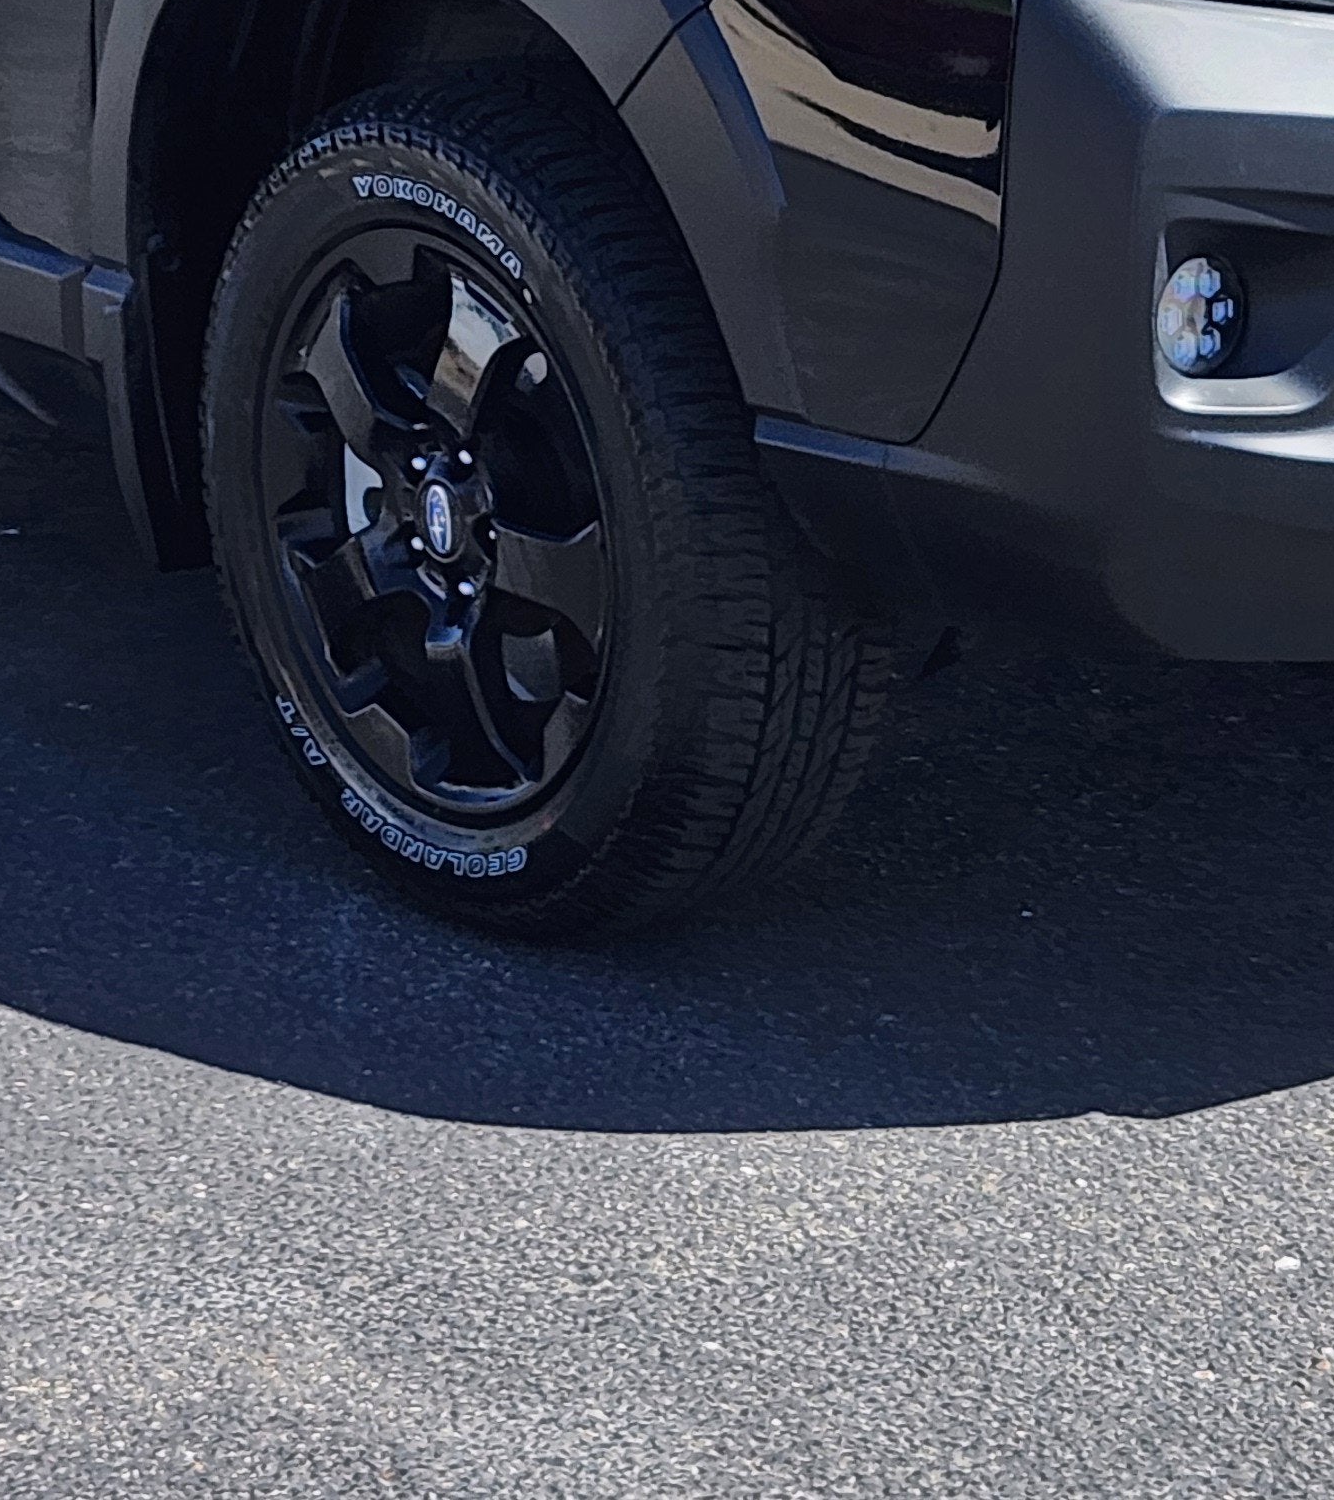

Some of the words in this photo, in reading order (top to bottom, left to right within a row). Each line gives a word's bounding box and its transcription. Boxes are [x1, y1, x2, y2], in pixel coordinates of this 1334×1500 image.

[352, 174, 523, 279] YOKOHAMA
[275, 695, 328, 766] A/T
[340, 788, 528, 878] GEOLANDAR
